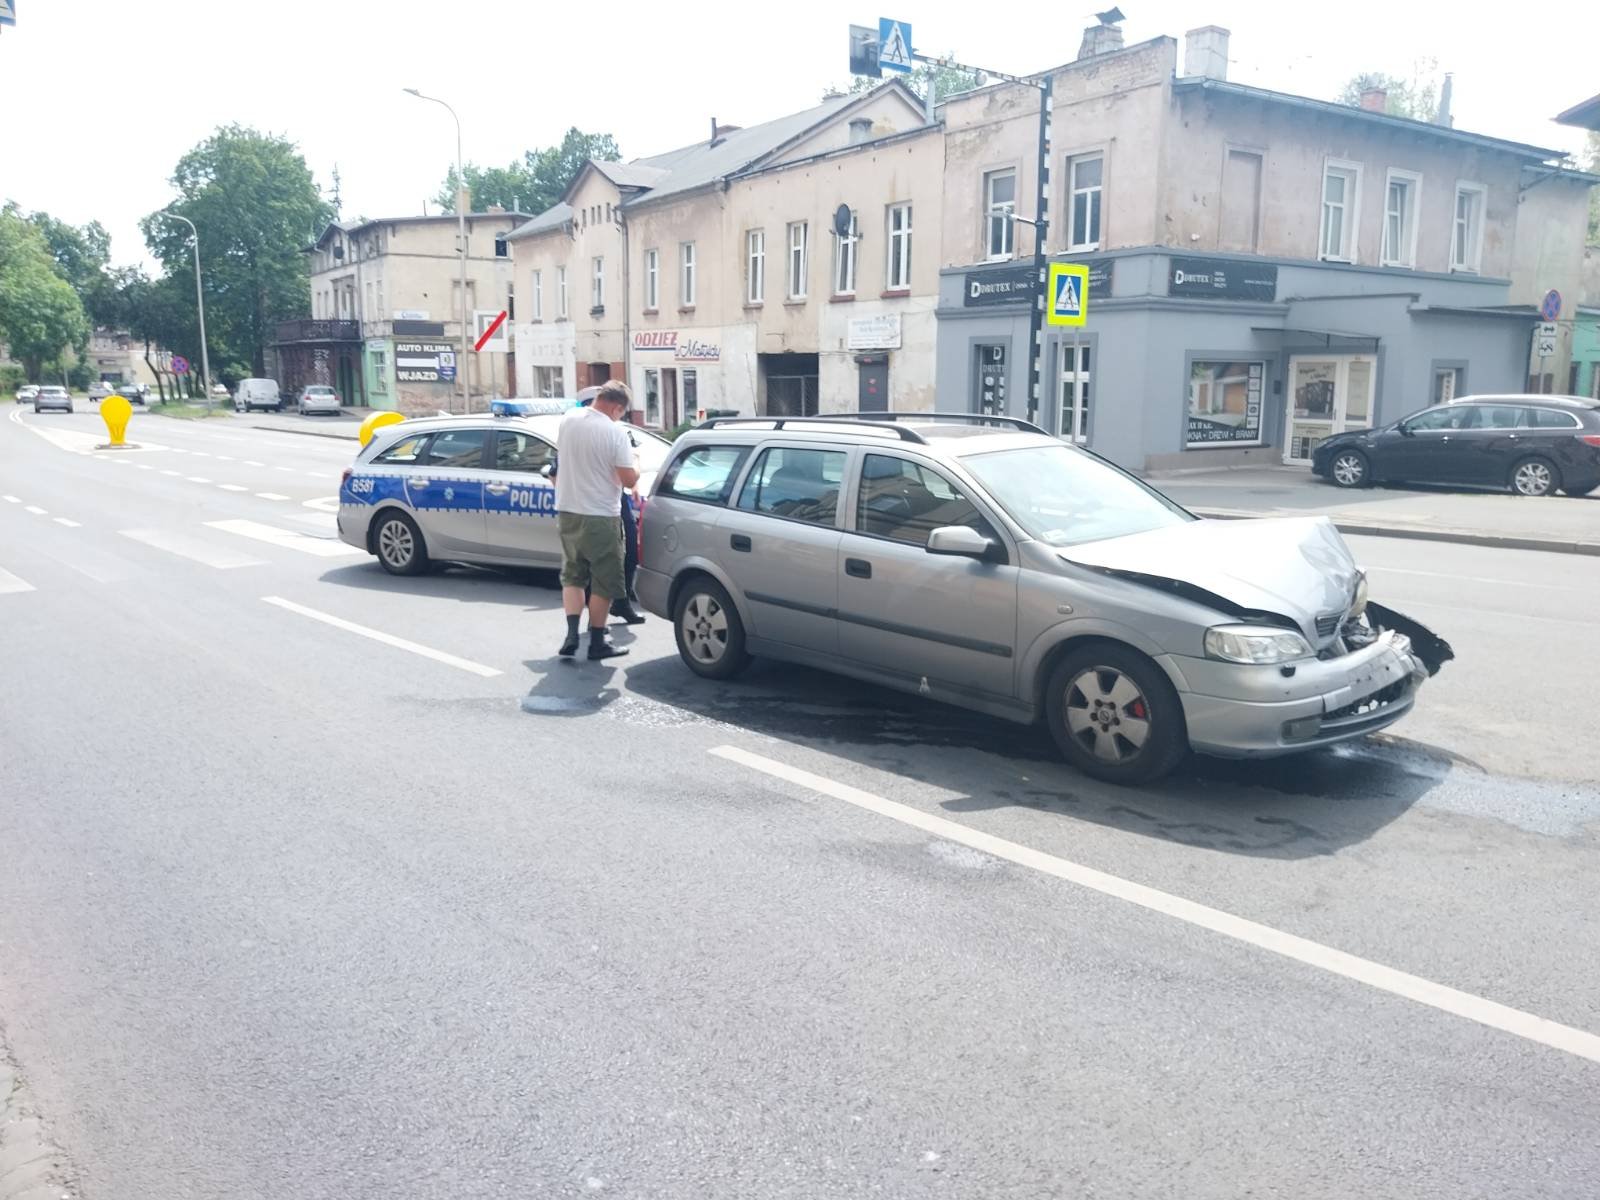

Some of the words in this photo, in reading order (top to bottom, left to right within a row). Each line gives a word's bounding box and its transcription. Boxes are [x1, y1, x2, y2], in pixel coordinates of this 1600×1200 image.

[397, 344, 422, 352] AUTO
[423, 344, 451, 352] KLIMA
[398, 371, 438, 381] WJAZD
